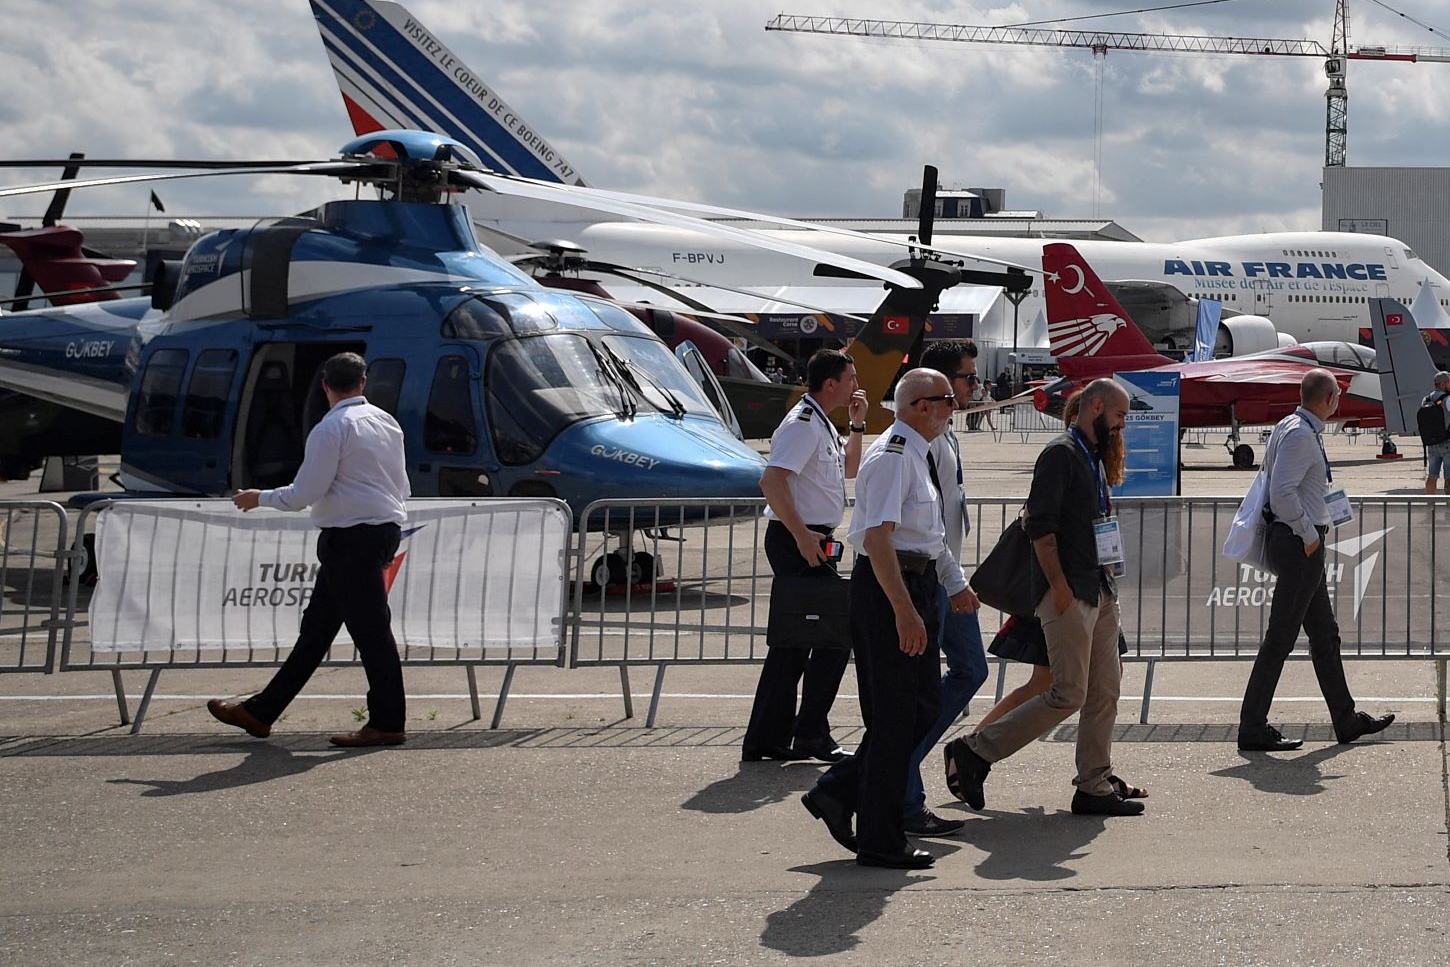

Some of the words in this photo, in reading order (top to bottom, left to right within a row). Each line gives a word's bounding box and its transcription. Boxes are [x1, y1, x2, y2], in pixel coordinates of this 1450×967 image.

[403, 18, 442, 58] VISITEZ
[440, 53, 455, 70] LE
[454, 67, 488, 101] COEUR
[488, 98, 505, 116] DE
[503, 113, 518, 129] CE
[517, 125, 555, 162] BOEING
[554, 160, 574, 178] 747
[672, 252, 725, 265] F-BPVJ
[1163, 259, 1234, 277] AIR
[1242, 261, 1388, 281] FRANCE
[1240, 277, 1255, 289] de
[1289, 280, 1301, 291] et
[1304, 280, 1320, 291] de
[222, 587, 313, 607] AEROSP
